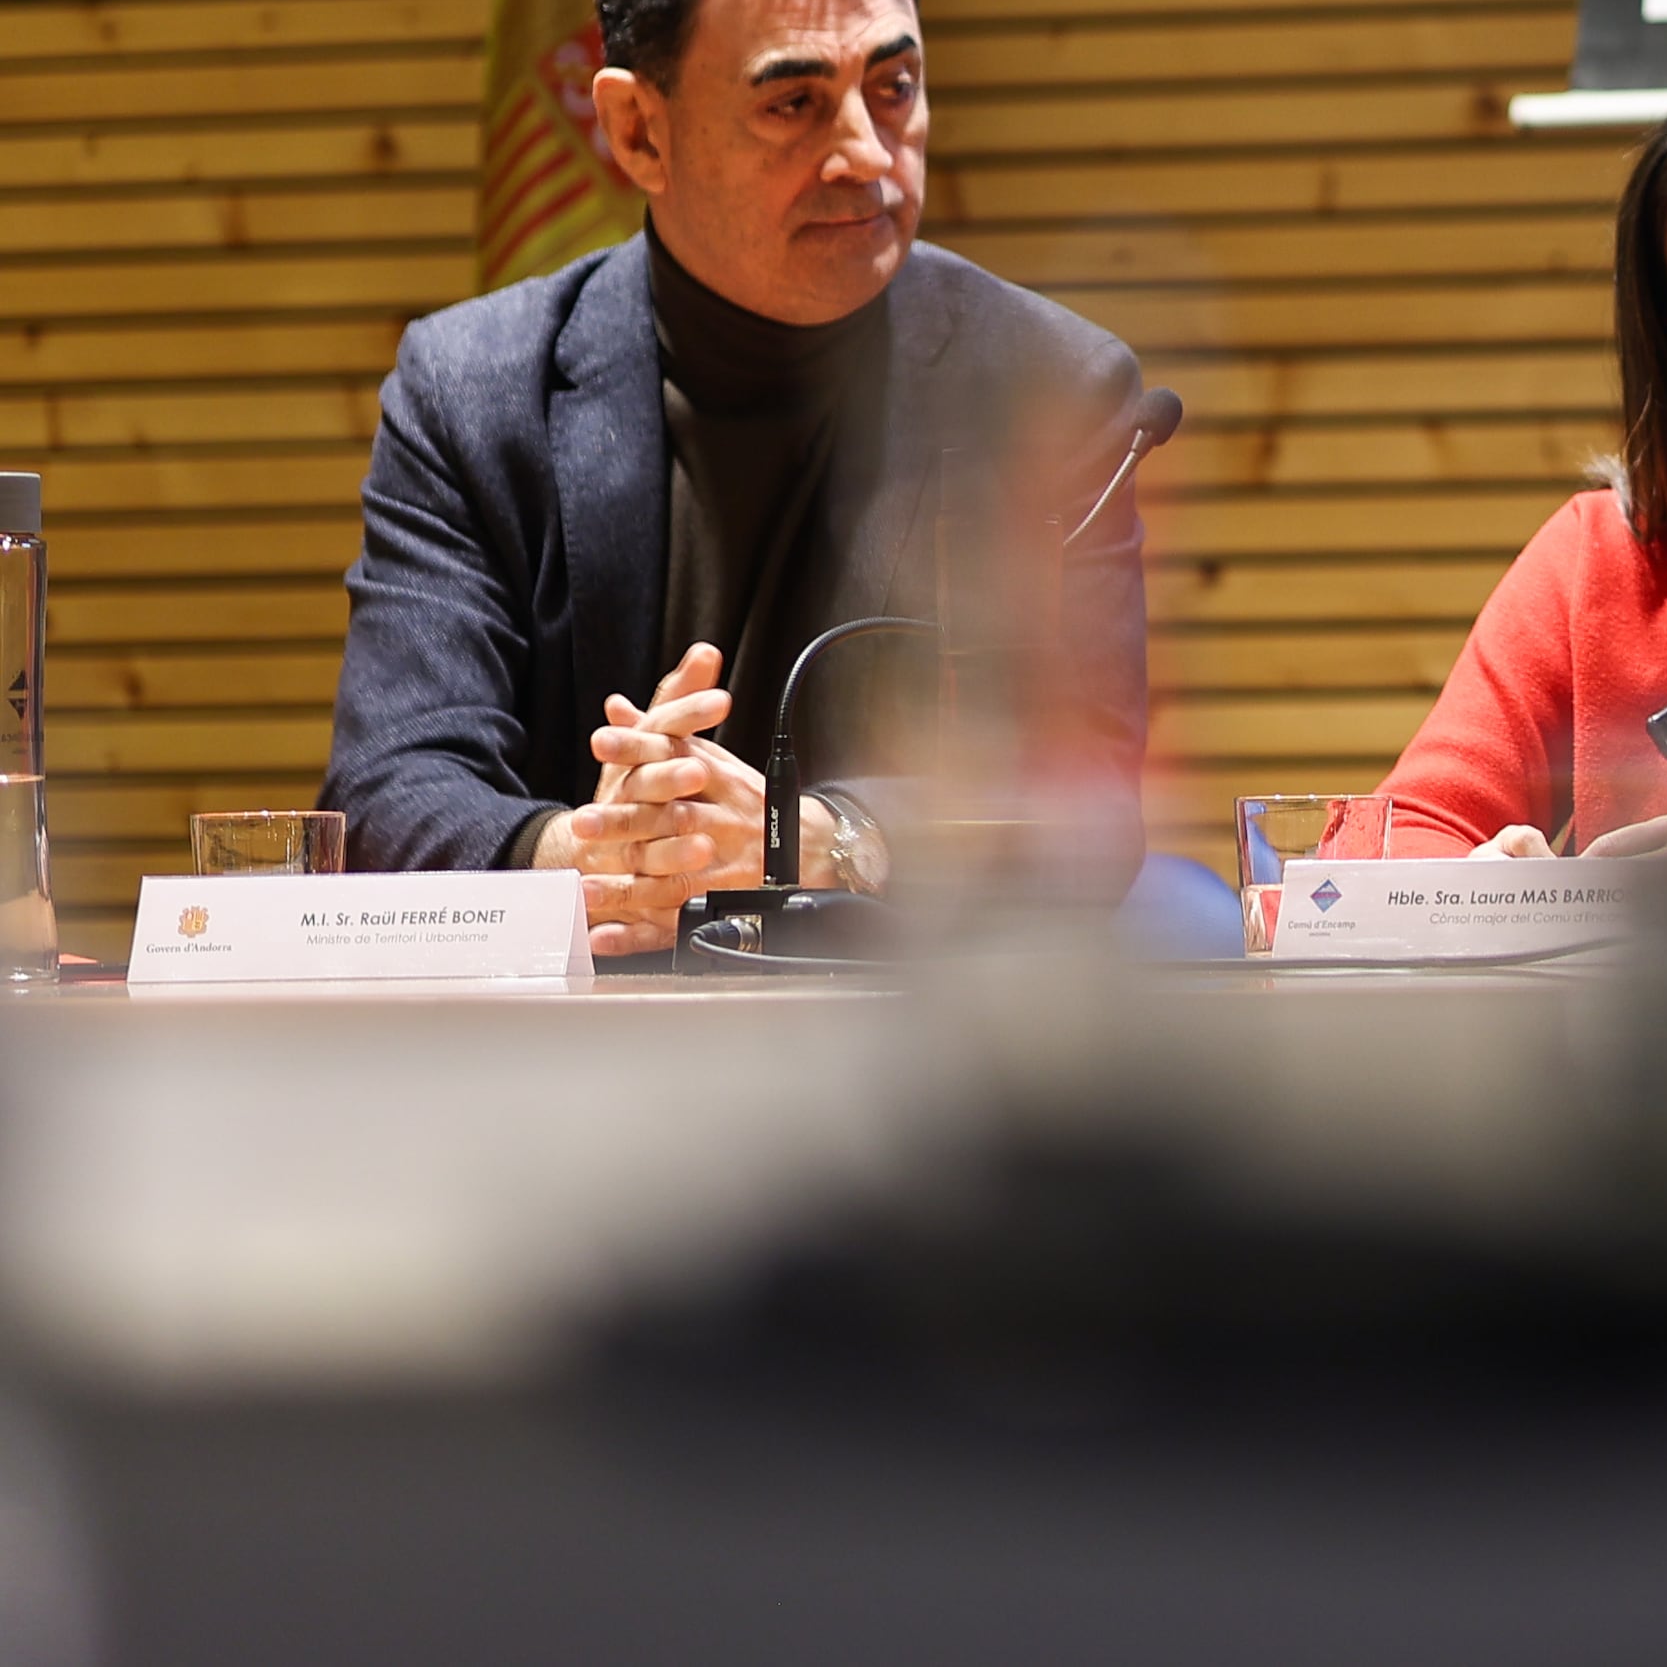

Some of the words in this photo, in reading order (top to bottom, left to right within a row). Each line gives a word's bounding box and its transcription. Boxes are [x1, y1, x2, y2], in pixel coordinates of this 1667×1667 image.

[1387, 891, 1429, 906] Hble.
[1434, 890, 1464, 905] Sra.
[1470, 890, 1516, 905] Laura
[1520, 889, 1558, 904] MAS
[1562, 887, 1626, 904] BARRIO
[300, 913, 330, 927] M.I.
[335, 912, 354, 926] Sr.
[360, 910, 396, 926] Raül
[400, 906, 448, 925] FERRÉ
[452, 910, 506, 924] BONET
[1429, 911, 1470, 925] Cònsol
[1473, 912, 1507, 927] major
[1510, 911, 1531, 924] del
[306, 933, 351, 945] Ministre
[355, 933, 371, 945] de
[375, 932, 416, 944] Territori
[425, 931, 489, 943] Urbanisme
[146, 943, 182, 953] Govern
